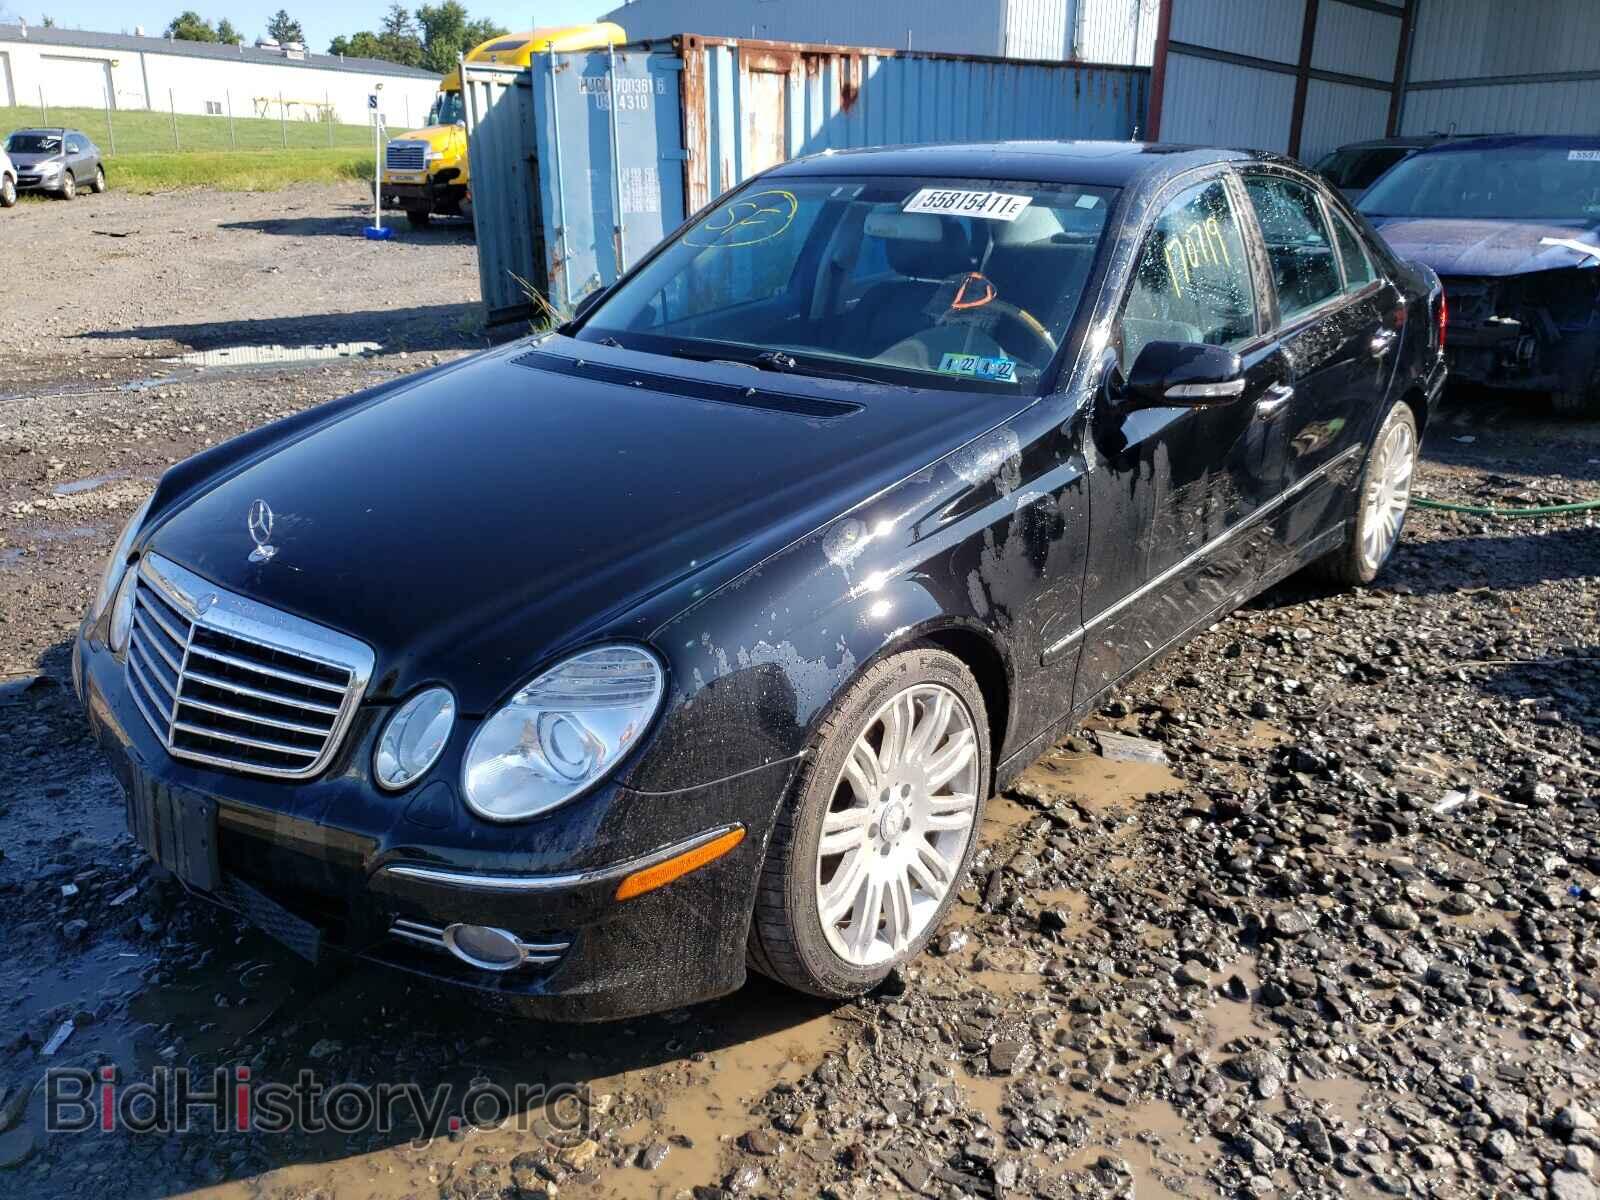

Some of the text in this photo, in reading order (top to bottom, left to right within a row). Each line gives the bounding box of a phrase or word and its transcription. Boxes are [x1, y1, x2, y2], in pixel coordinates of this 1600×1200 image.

[619, 94, 648, 110] 4310
[961, 357, 975, 371] 22
[998, 362, 1012, 376] 22
